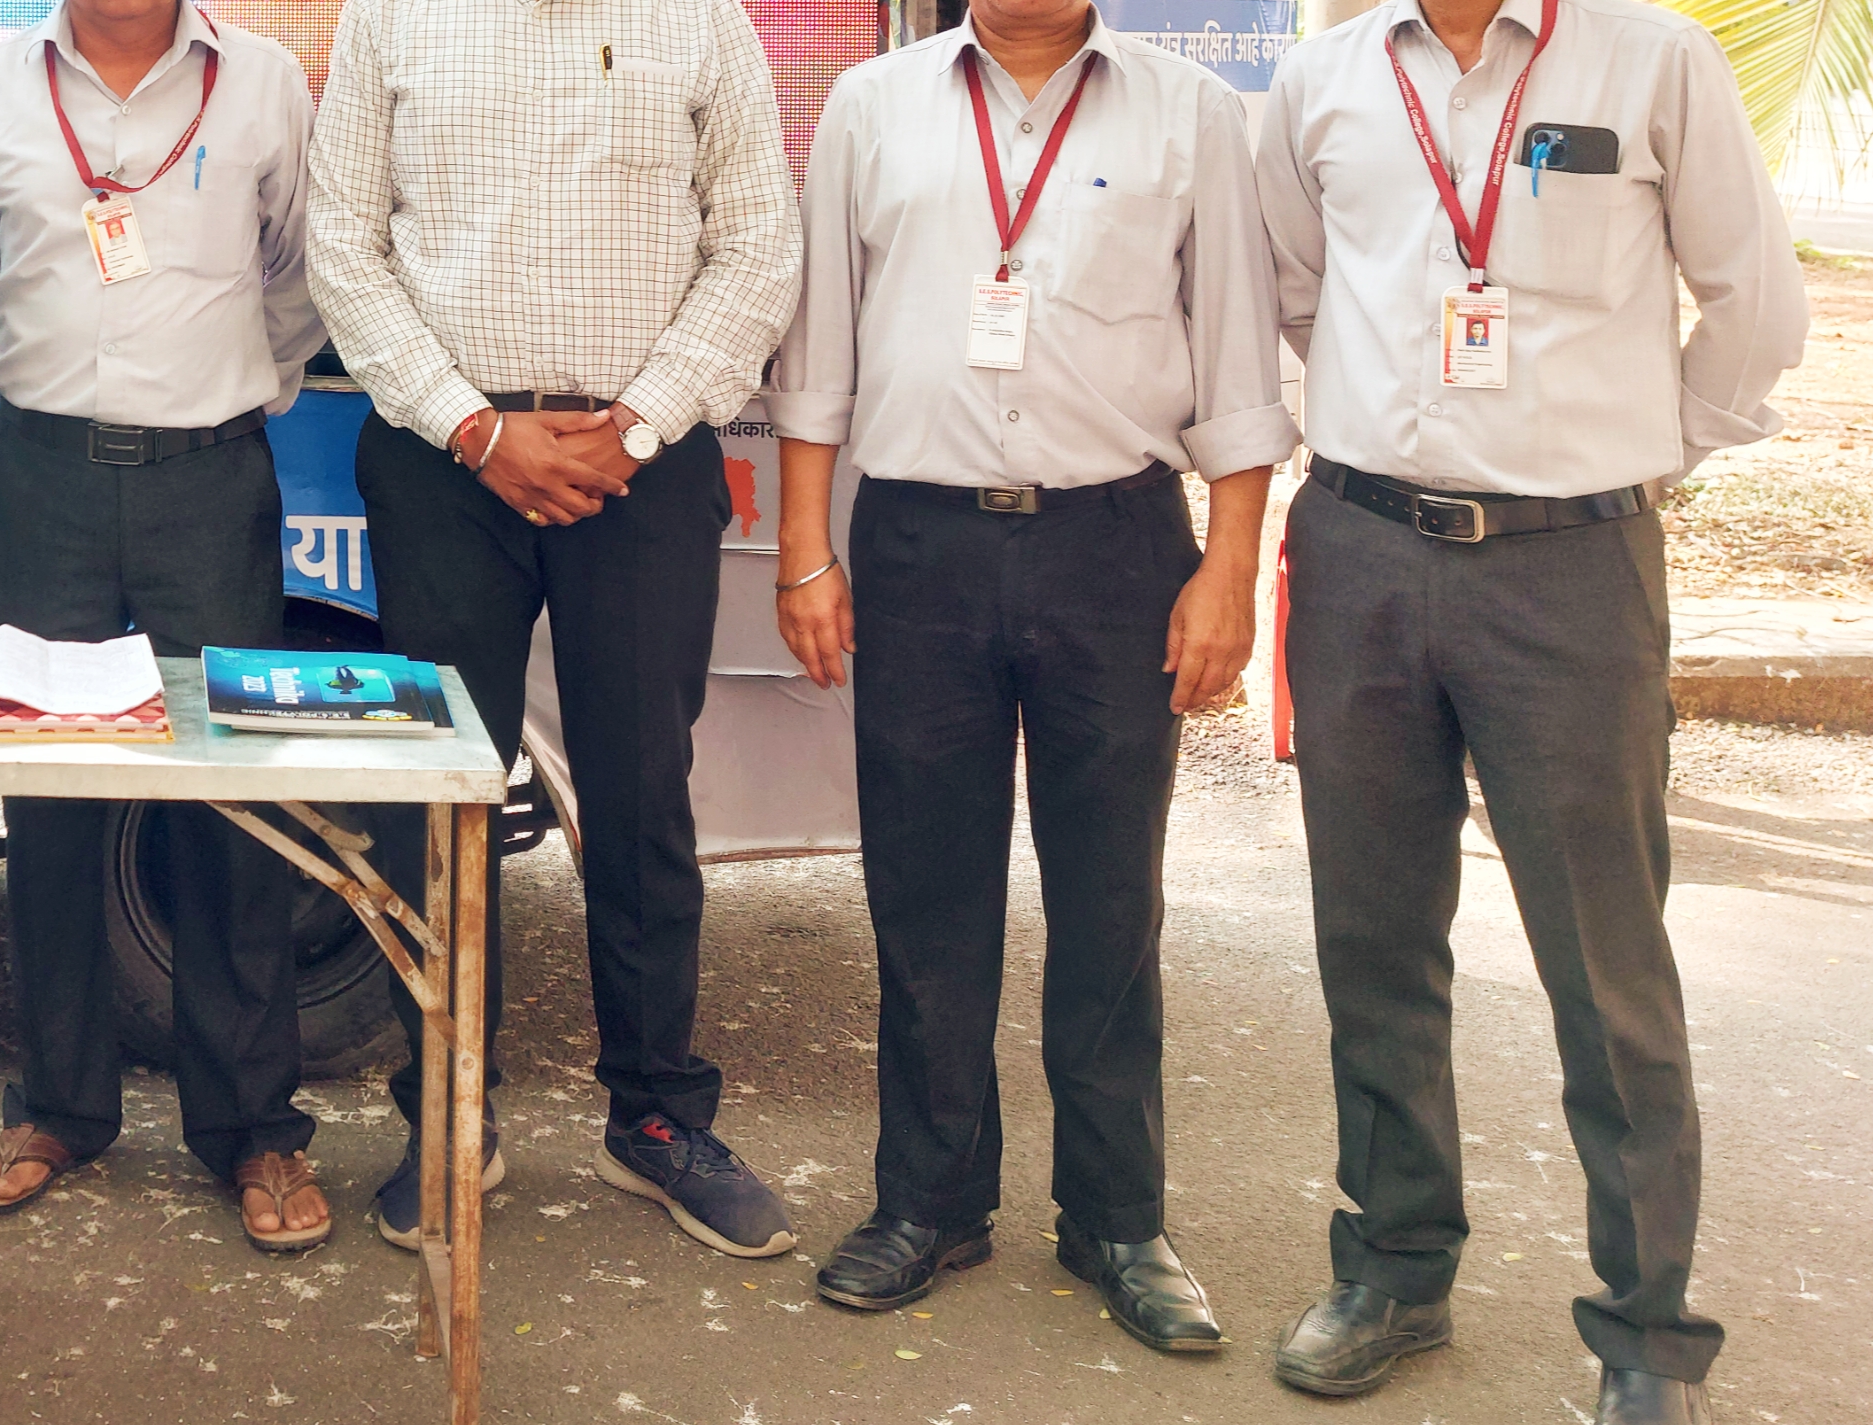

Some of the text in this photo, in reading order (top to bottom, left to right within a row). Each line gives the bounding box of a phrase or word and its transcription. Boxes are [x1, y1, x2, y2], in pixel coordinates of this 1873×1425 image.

[1184, 20, 1233, 68] सरक्षित
[1235, 22, 1259, 67] आहे
[240, 674, 268, 693] 2023
[269, 666, 306, 705] Technika
